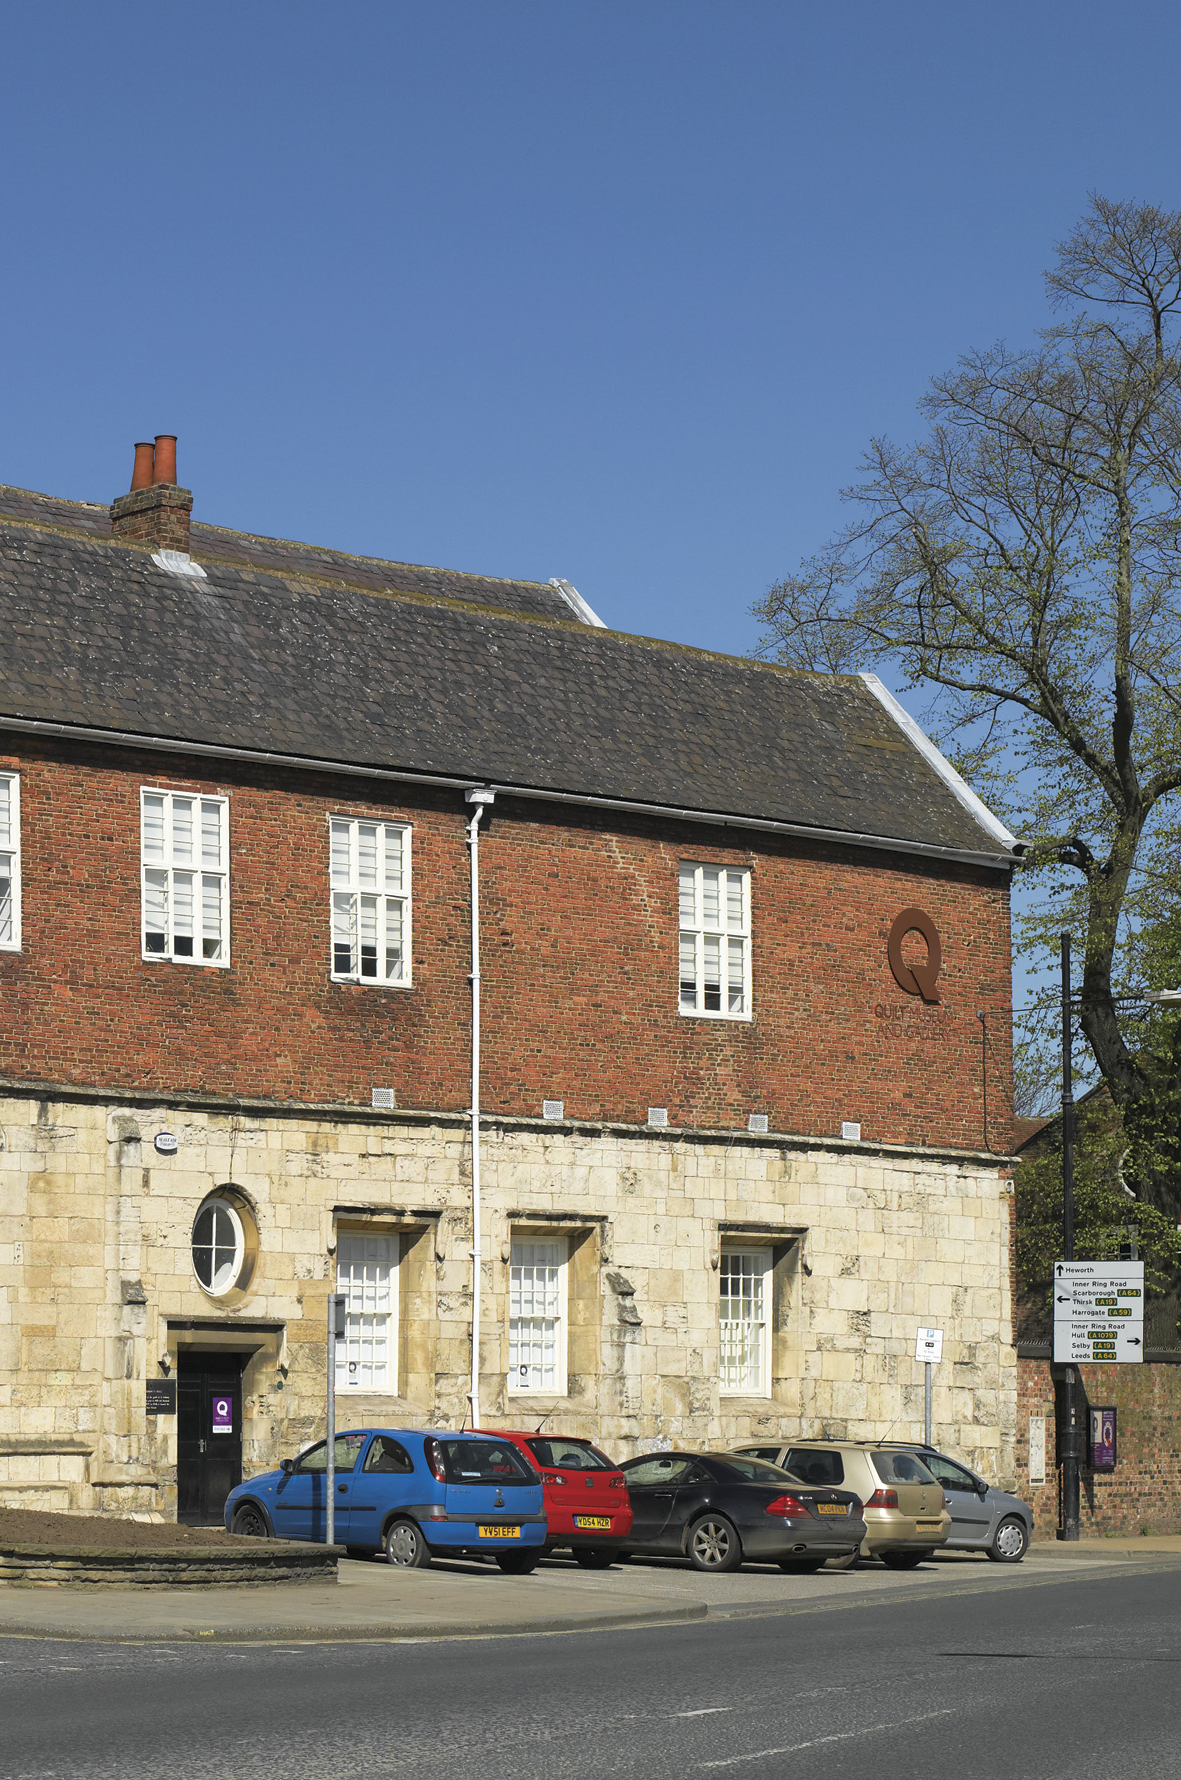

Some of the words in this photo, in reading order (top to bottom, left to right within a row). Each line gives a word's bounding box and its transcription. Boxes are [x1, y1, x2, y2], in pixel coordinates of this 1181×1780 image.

[888, 908, 941, 1001] Q
[875, 1003, 907, 1021] QUILT
[217, 1401, 227, 1416] Q
[579, 1517, 595, 1526] YD54
[597, 1518, 609, 1527] HZR
[483, 1527, 500, 1536] YV51
[502, 1527, 516, 1536] EFF
